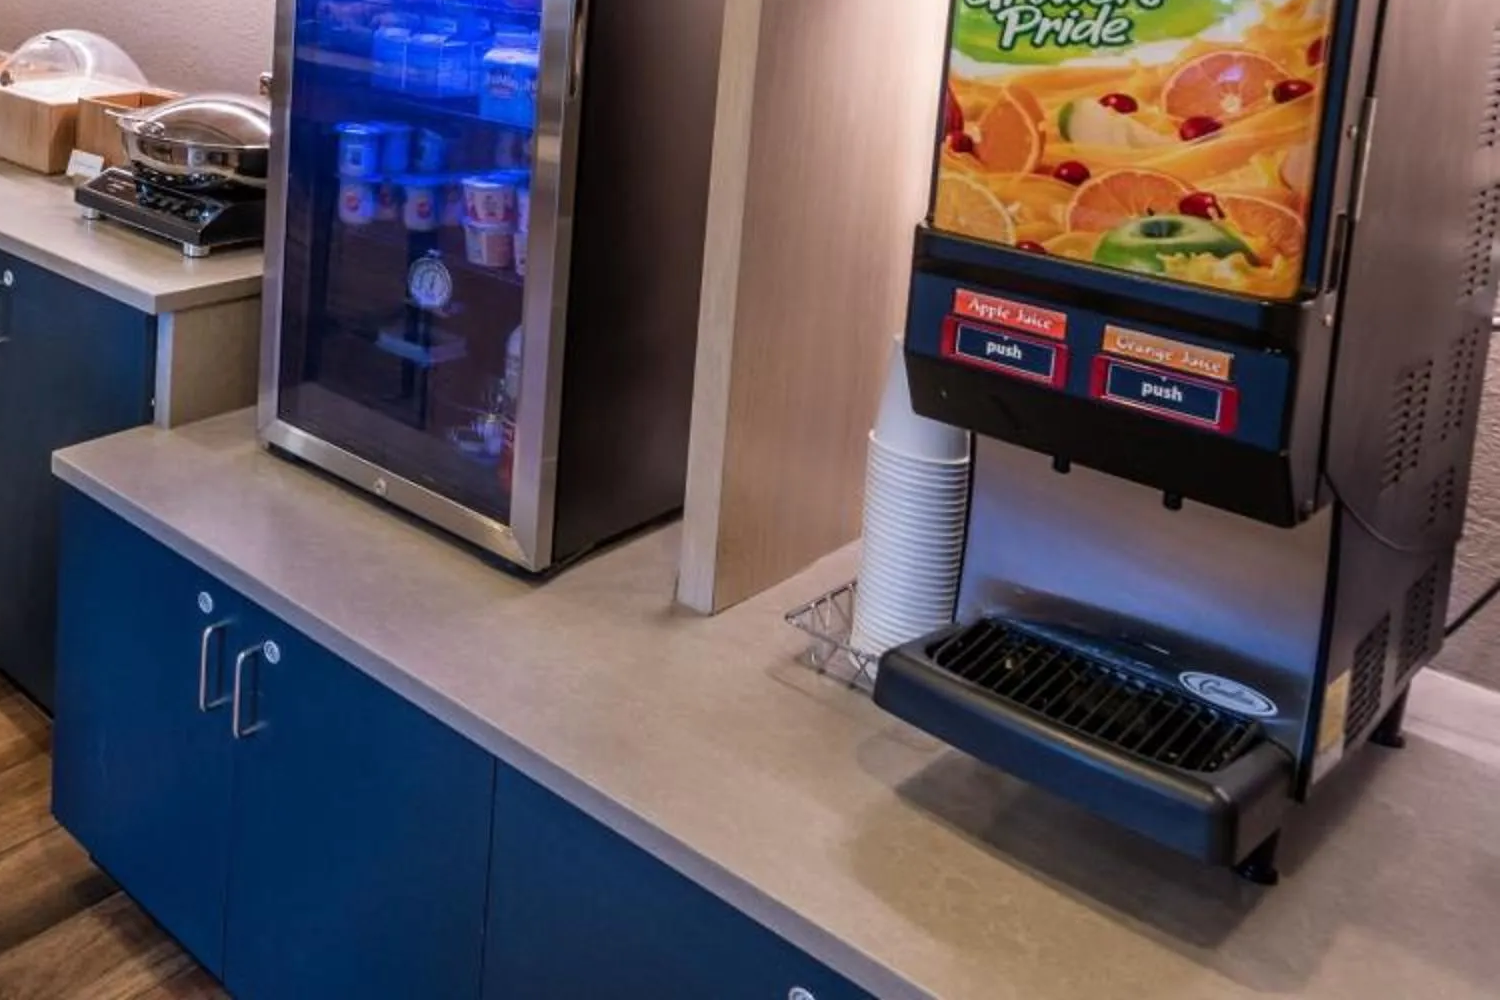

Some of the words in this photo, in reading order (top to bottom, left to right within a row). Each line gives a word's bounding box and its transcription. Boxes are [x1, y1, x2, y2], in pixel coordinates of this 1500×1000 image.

[997, 3, 1133, 50] Pride
[966, 297, 1010, 322] Apple
[1014, 308, 1052, 330] Juice
[985, 338, 1023, 360] push
[1115, 333, 1174, 362] Orange
[1181, 350, 1222, 374] Juice
[1140, 380, 1183, 402] push
